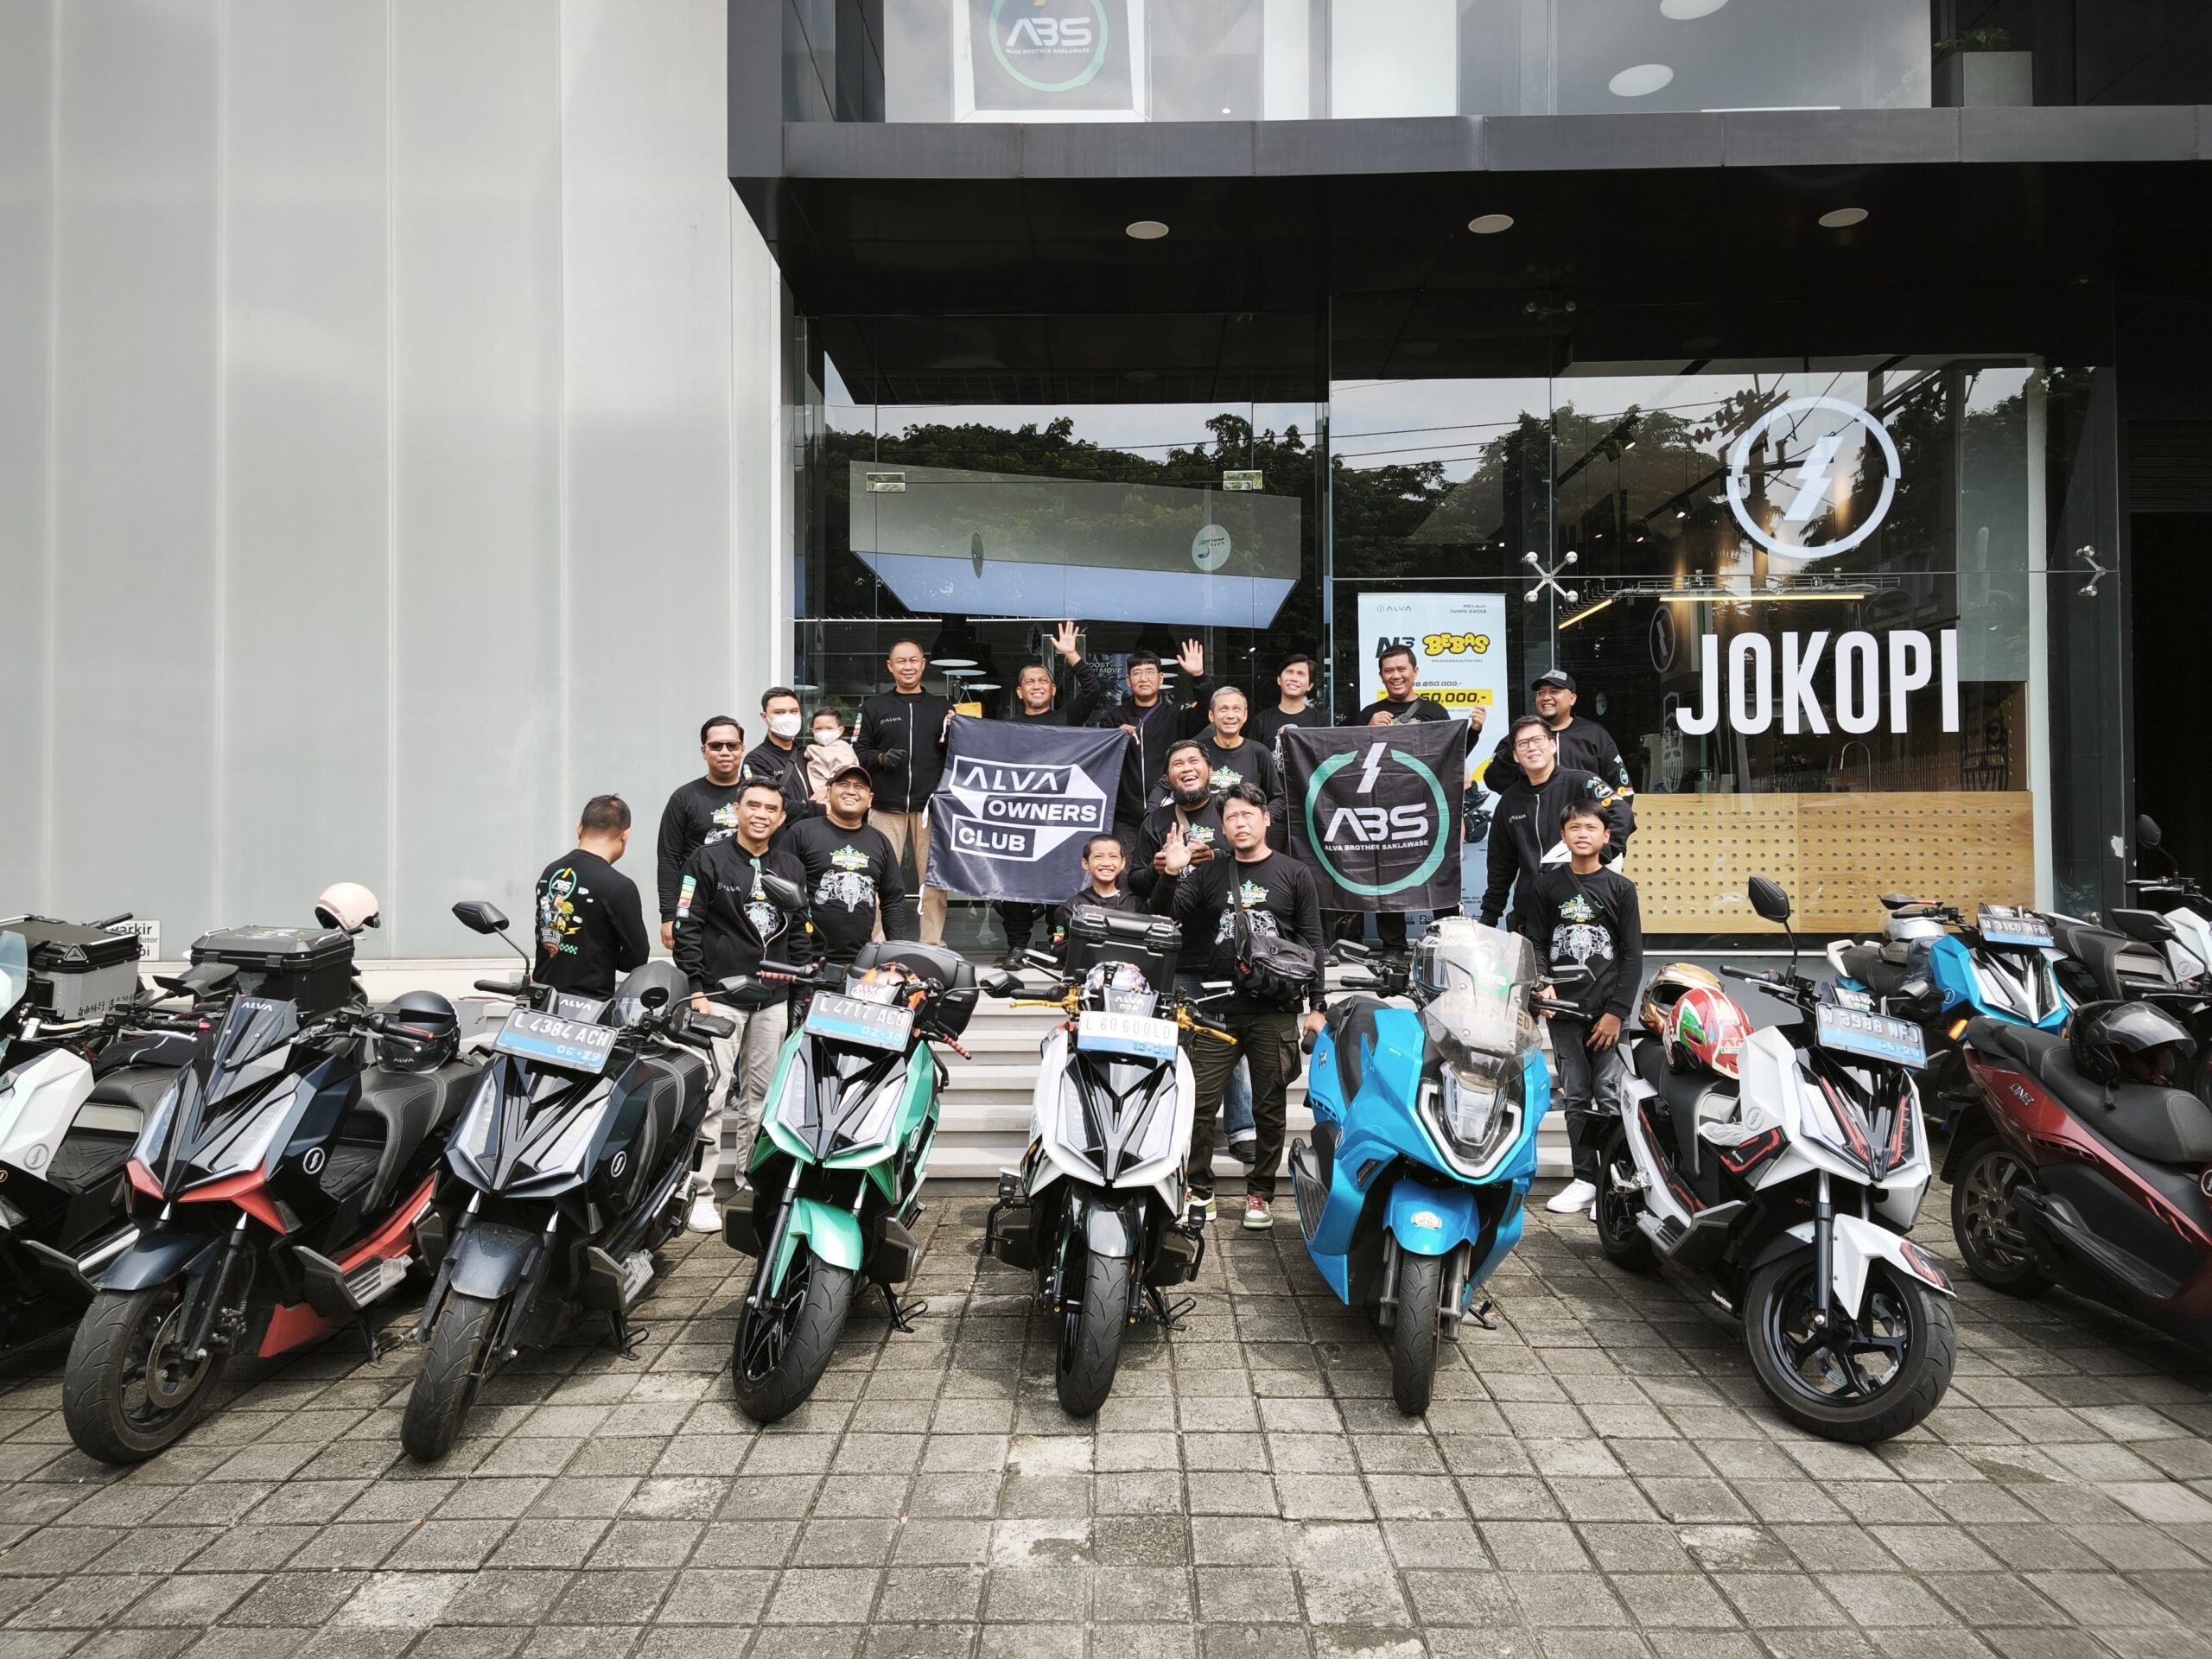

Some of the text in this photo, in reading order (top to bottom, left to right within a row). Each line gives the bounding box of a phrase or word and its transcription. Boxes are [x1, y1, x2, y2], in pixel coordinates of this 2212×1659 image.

[1006, 17, 1091, 47] ABS
[1422, 632, 1491, 657] BEBAS
[1675, 629, 1959, 735] JOKOPI
[963, 766, 1058, 791] ALVA
[988, 800, 1097, 822] OWNERS
[1324, 803, 1429, 842] ABS
[958, 827, 1026, 852] CLUB
[1382, 840, 1429, 850] SAKLAWASE
[241, 1002, 273, 1012] ALVA
[560, 999, 591, 1011] ALVA
[819, 997, 828, 1012] L
[833, 1000, 873, 1020] 4717
[1115, 995, 1145, 1007] ALVA
[514, 1014, 610, 1047] L 4384 ACH
[2010, 1084, 2035, 1106] ONE
